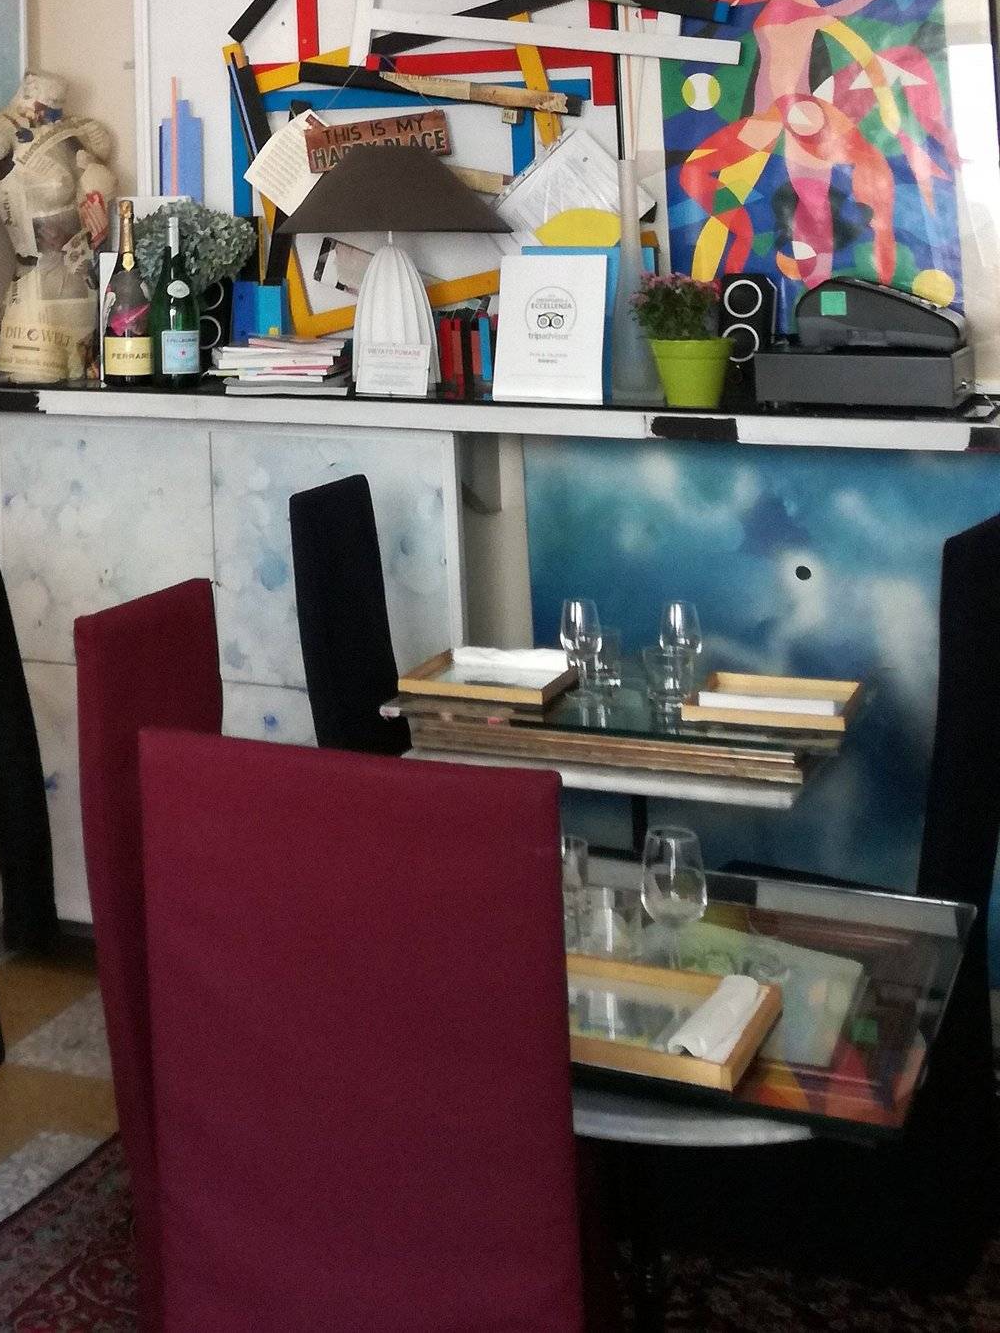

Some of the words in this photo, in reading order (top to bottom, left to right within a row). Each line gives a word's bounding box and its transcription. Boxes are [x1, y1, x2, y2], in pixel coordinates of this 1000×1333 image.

[322, 126, 362, 145] THIS
[370, 121, 386, 137] IS
[396, 115, 424, 133] MY
[311, 140, 378, 169] HAP
